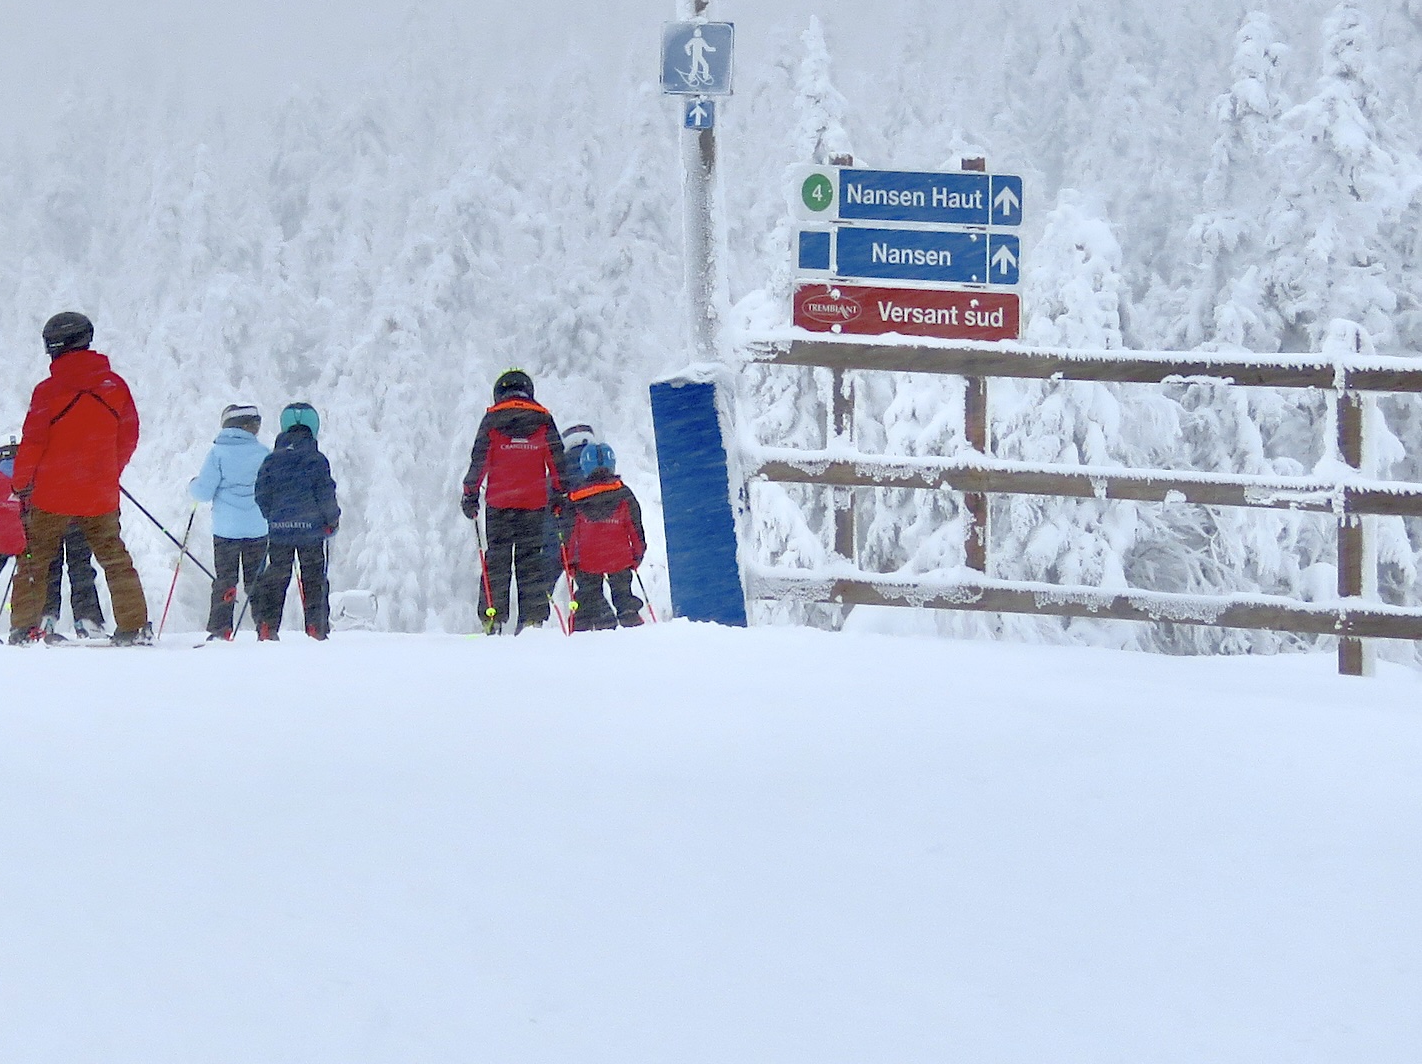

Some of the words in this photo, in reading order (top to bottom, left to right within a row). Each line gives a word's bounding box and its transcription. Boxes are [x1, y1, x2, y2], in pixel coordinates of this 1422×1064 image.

[812, 184, 823, 202] 4
[847, 183, 925, 207] Nansen
[932, 187, 983, 209] Haut
[872, 242, 952, 266] Nansen
[808, 303, 858, 320] TREMBLANT
[878, 301, 959, 326] Versant
[964, 307, 1004, 327] sud
